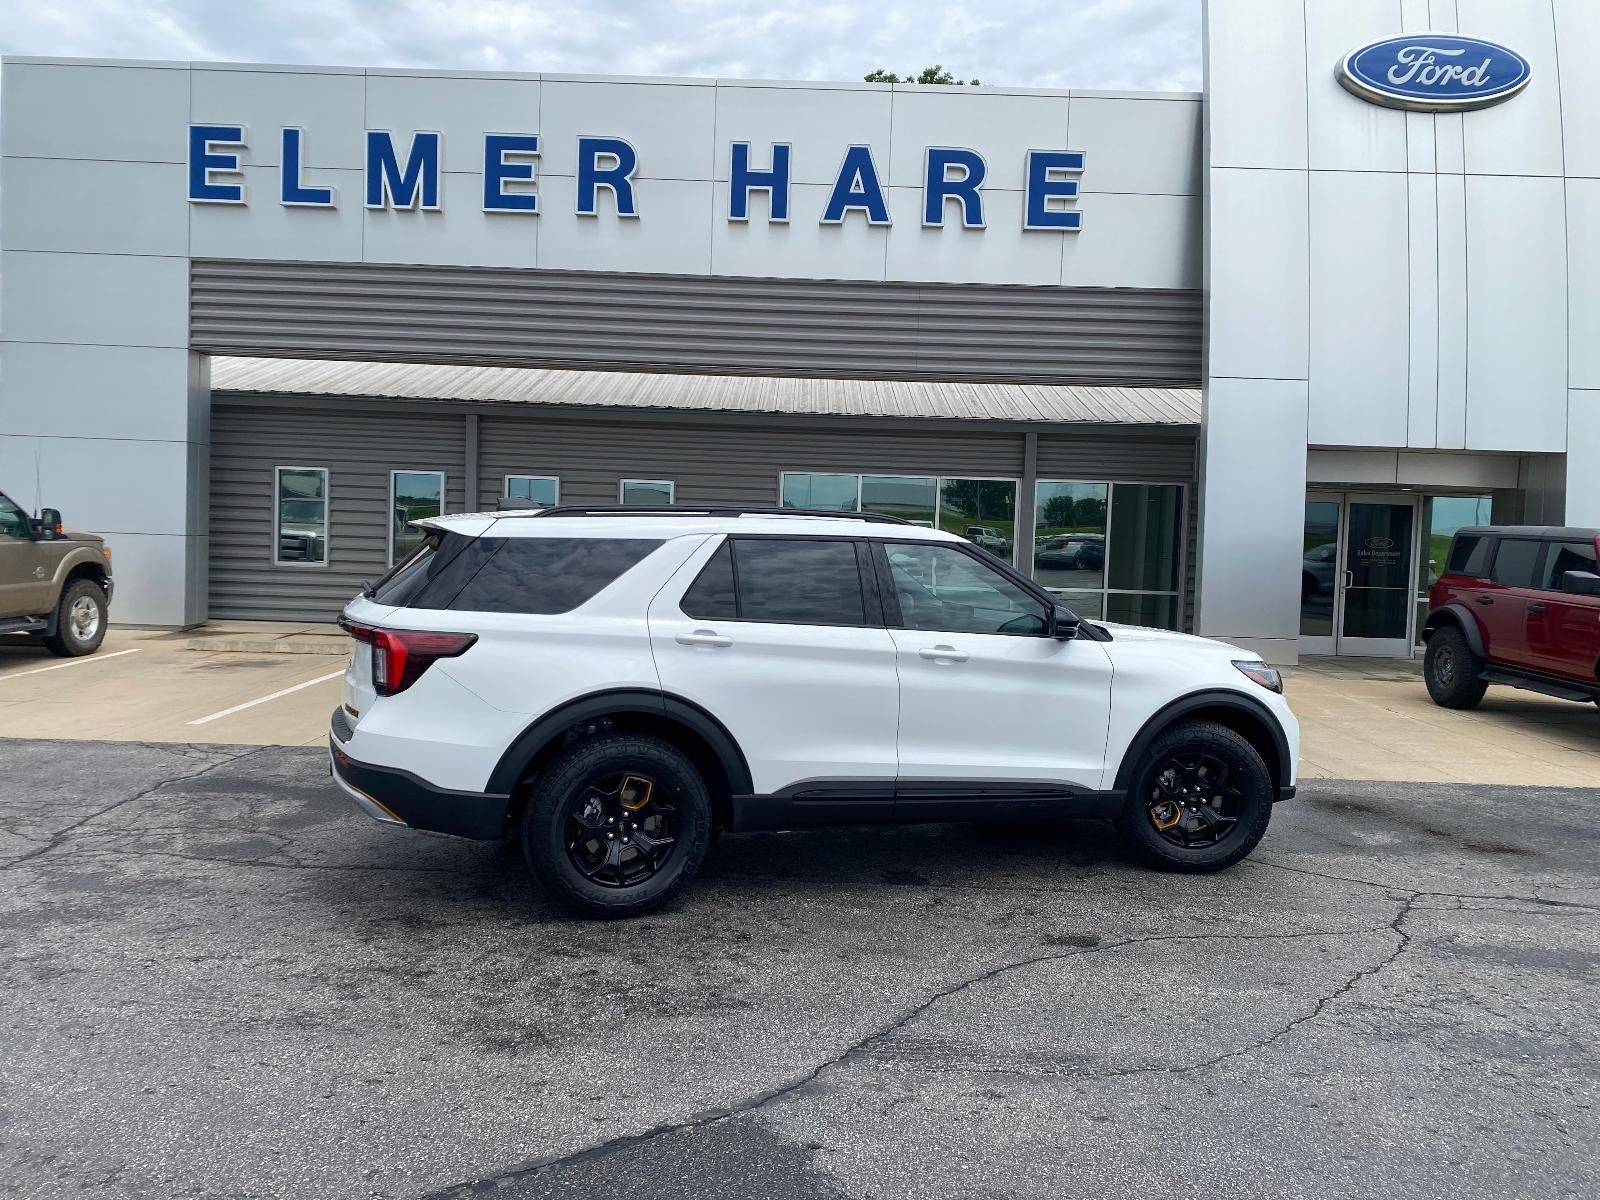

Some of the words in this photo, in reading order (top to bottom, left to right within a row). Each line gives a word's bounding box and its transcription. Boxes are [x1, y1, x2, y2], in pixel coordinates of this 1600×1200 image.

[1387, 46, 1492, 87] Ford
[188, 123, 640, 217] ELMER
[727, 140, 1087, 232] HARE
